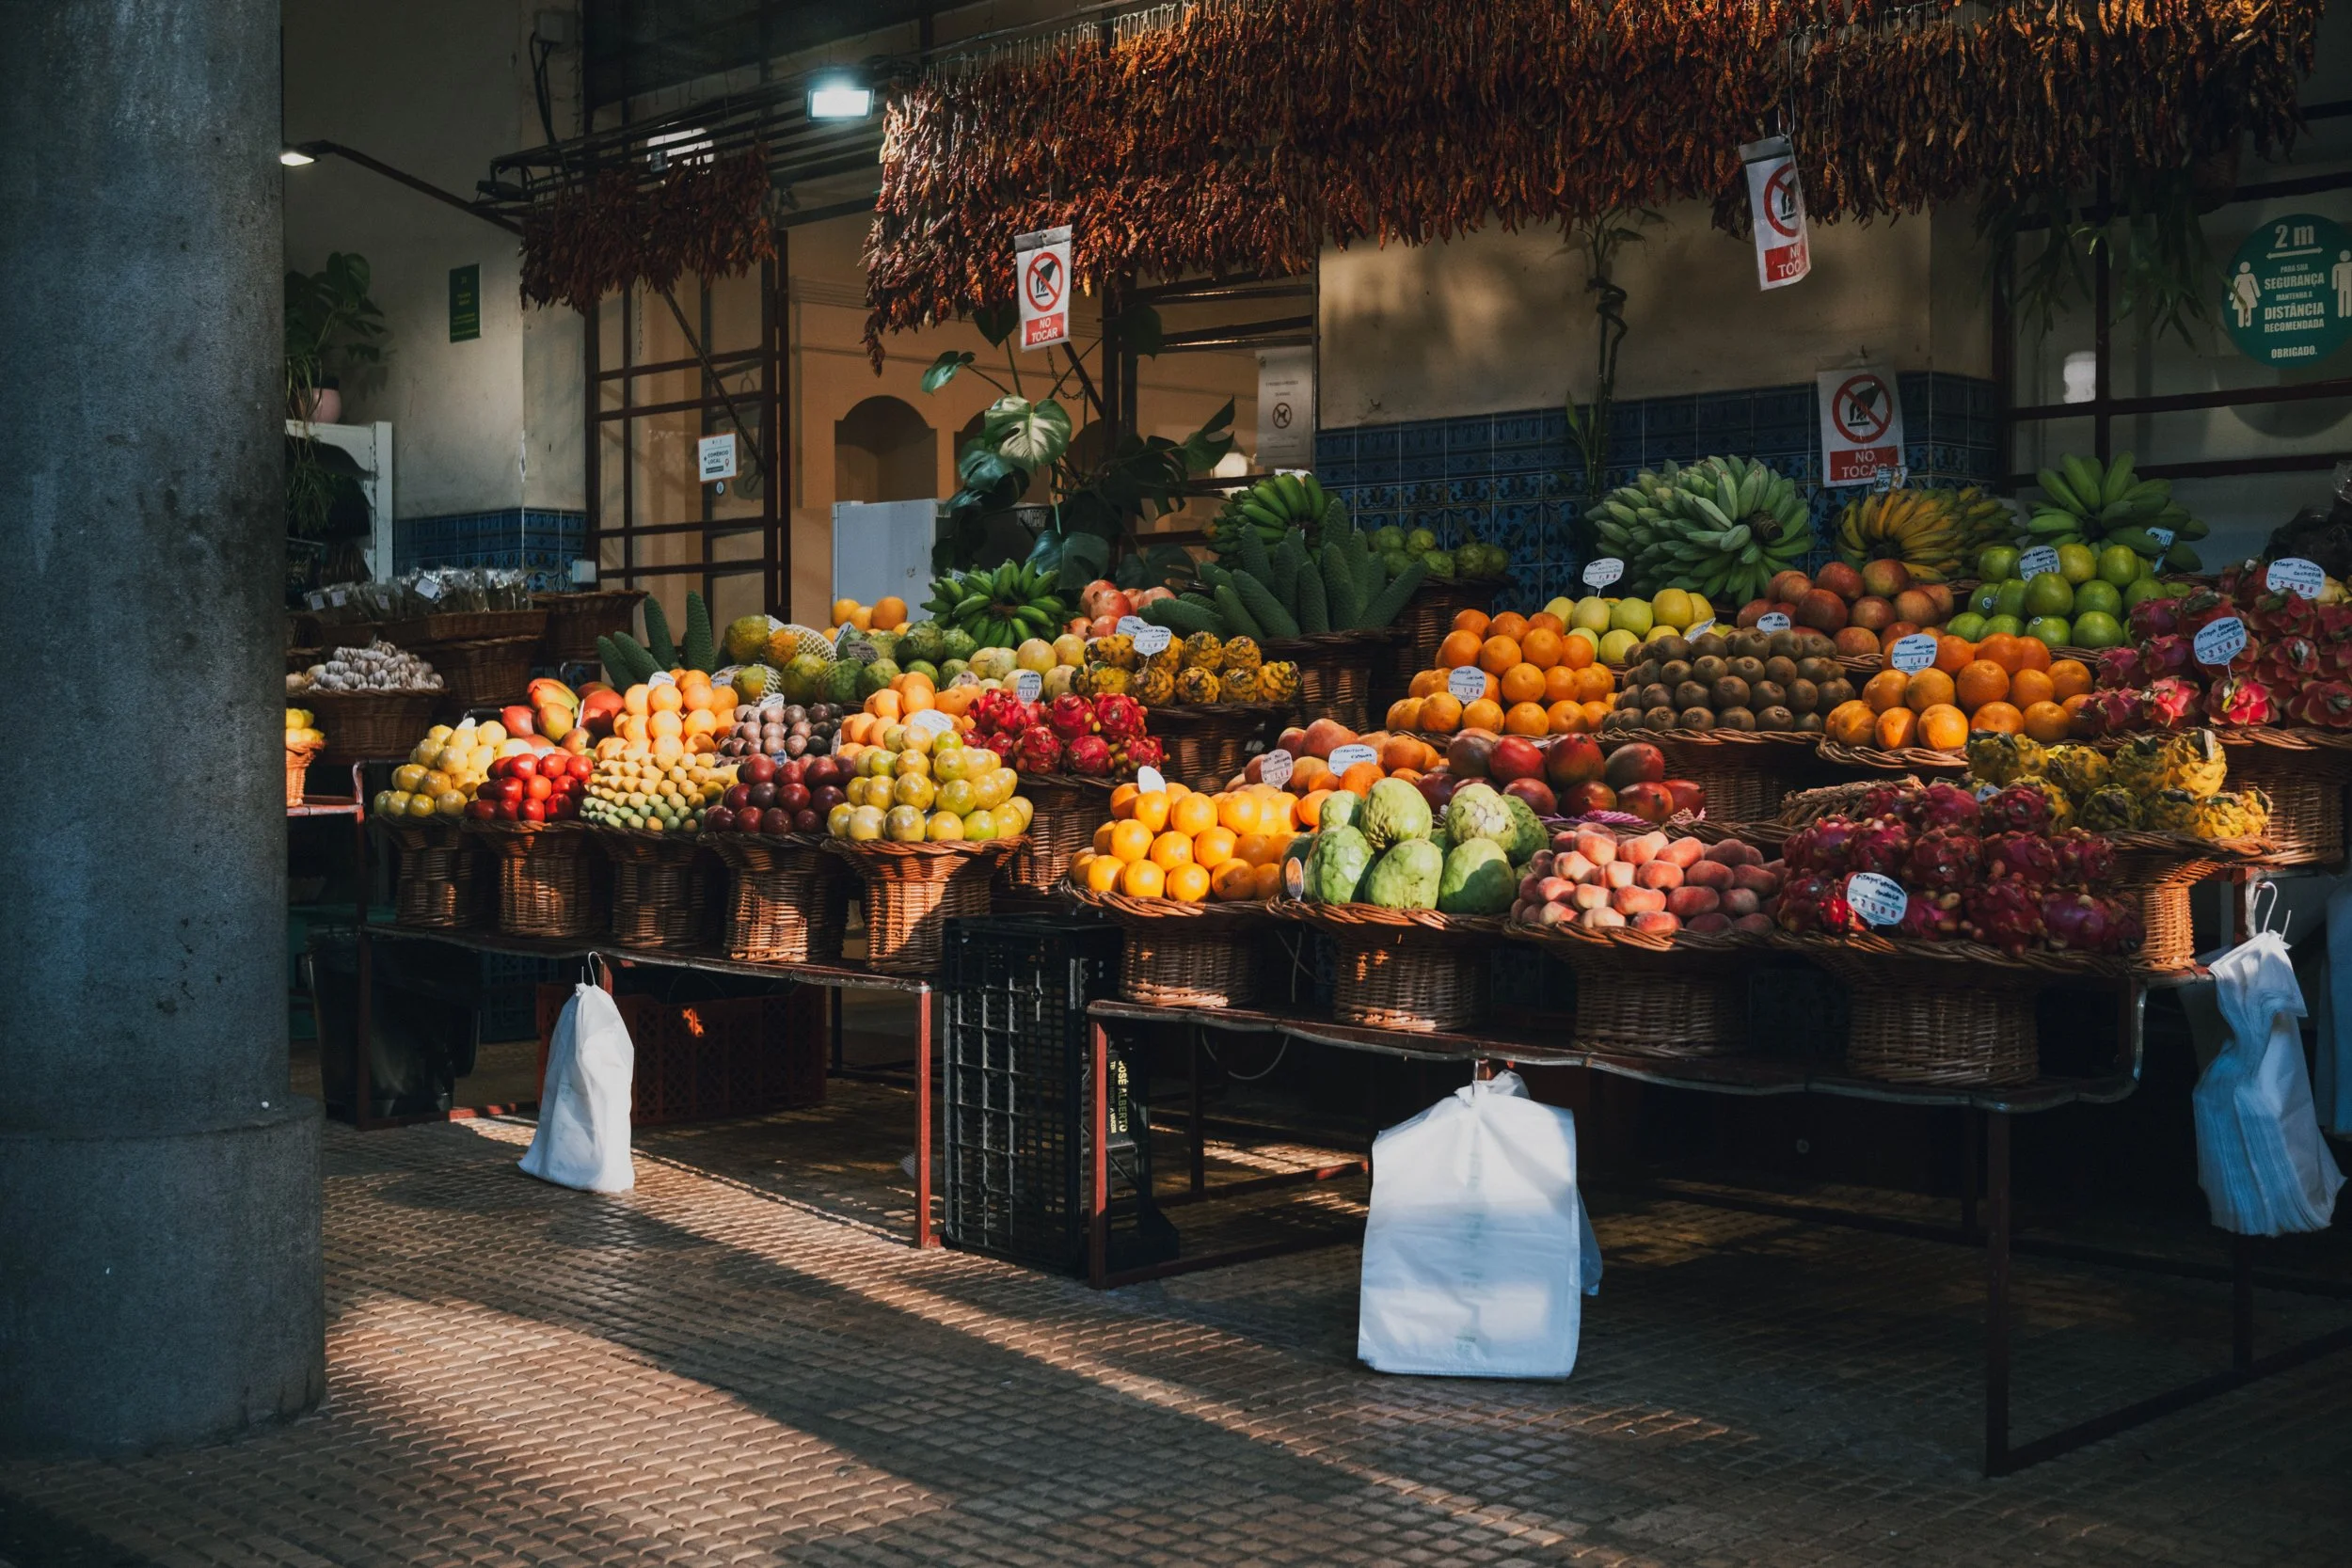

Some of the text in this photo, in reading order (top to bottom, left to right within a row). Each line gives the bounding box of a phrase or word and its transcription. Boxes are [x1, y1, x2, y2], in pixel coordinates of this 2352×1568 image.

[2275, 225, 2314, 249] 2 m
[2280, 263, 2309, 273] PARA SUA
[2265, 272, 2325, 291] SEGURANÇA
[2276, 292, 2308, 301] MANTENHA
[2265, 302, 2325, 320] DISTÂNCIA
[1040, 318, 1051, 329] NO
[2265, 319, 2325, 333] RECOMENDADA
[1031, 327, 1057, 342] TOCAR
[2271, 345, 2317, 358] OBRIGADO.
[1855, 450, 1875, 463] NO
[1118, 1060, 1130, 1132] JOSÉ ALBERTO
